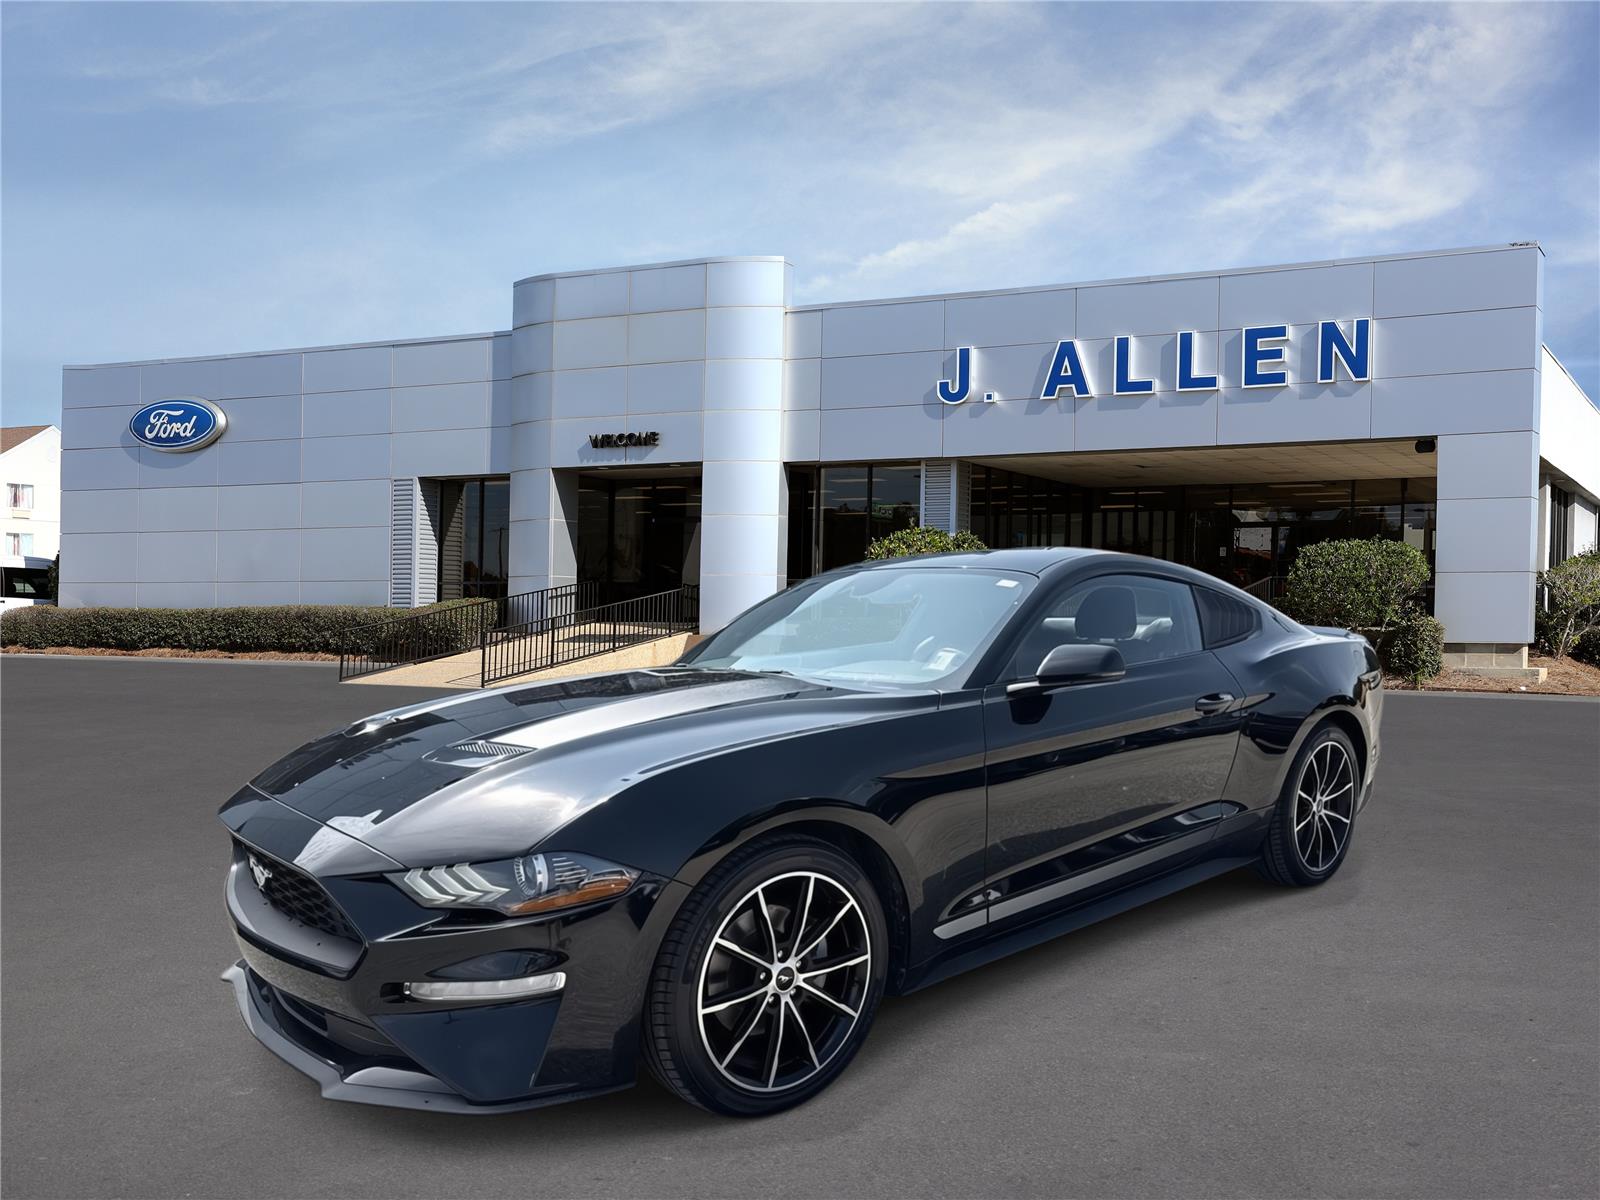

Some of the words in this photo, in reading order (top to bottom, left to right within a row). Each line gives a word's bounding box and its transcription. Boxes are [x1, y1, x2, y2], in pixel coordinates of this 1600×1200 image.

[937, 346, 996, 404] J.
[1041, 318, 1371, 399] ALLEN
[144, 409, 197, 439] Ford
[589, 431, 660, 449] WELCOME
